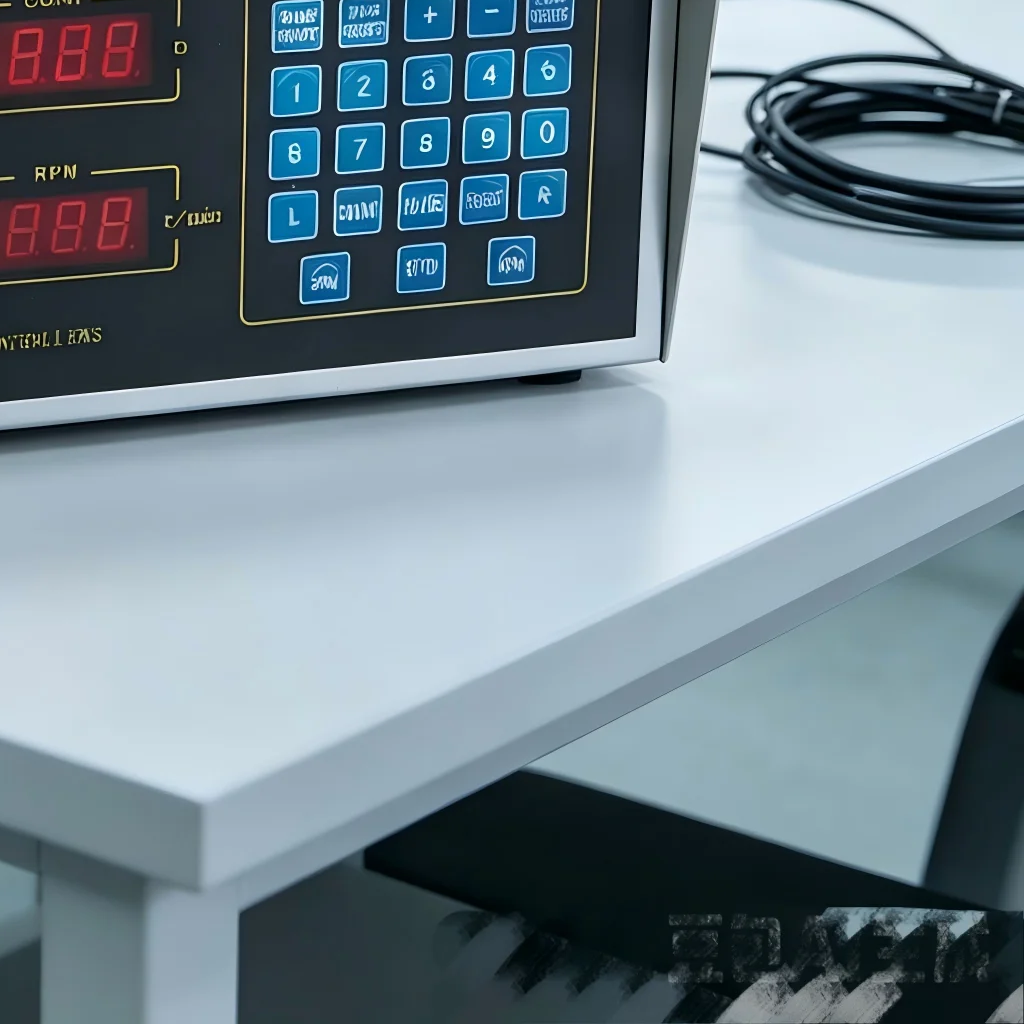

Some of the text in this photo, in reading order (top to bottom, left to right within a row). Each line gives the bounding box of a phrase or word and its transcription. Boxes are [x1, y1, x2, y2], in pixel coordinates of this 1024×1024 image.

[357, 75, 371, 97] 2
[482, 64, 497, 86] 4
[353, 138, 368, 160] 7
[419, 133, 433, 153] 8
[481, 127, 495, 149] 9
[288, 207, 300, 226] L
